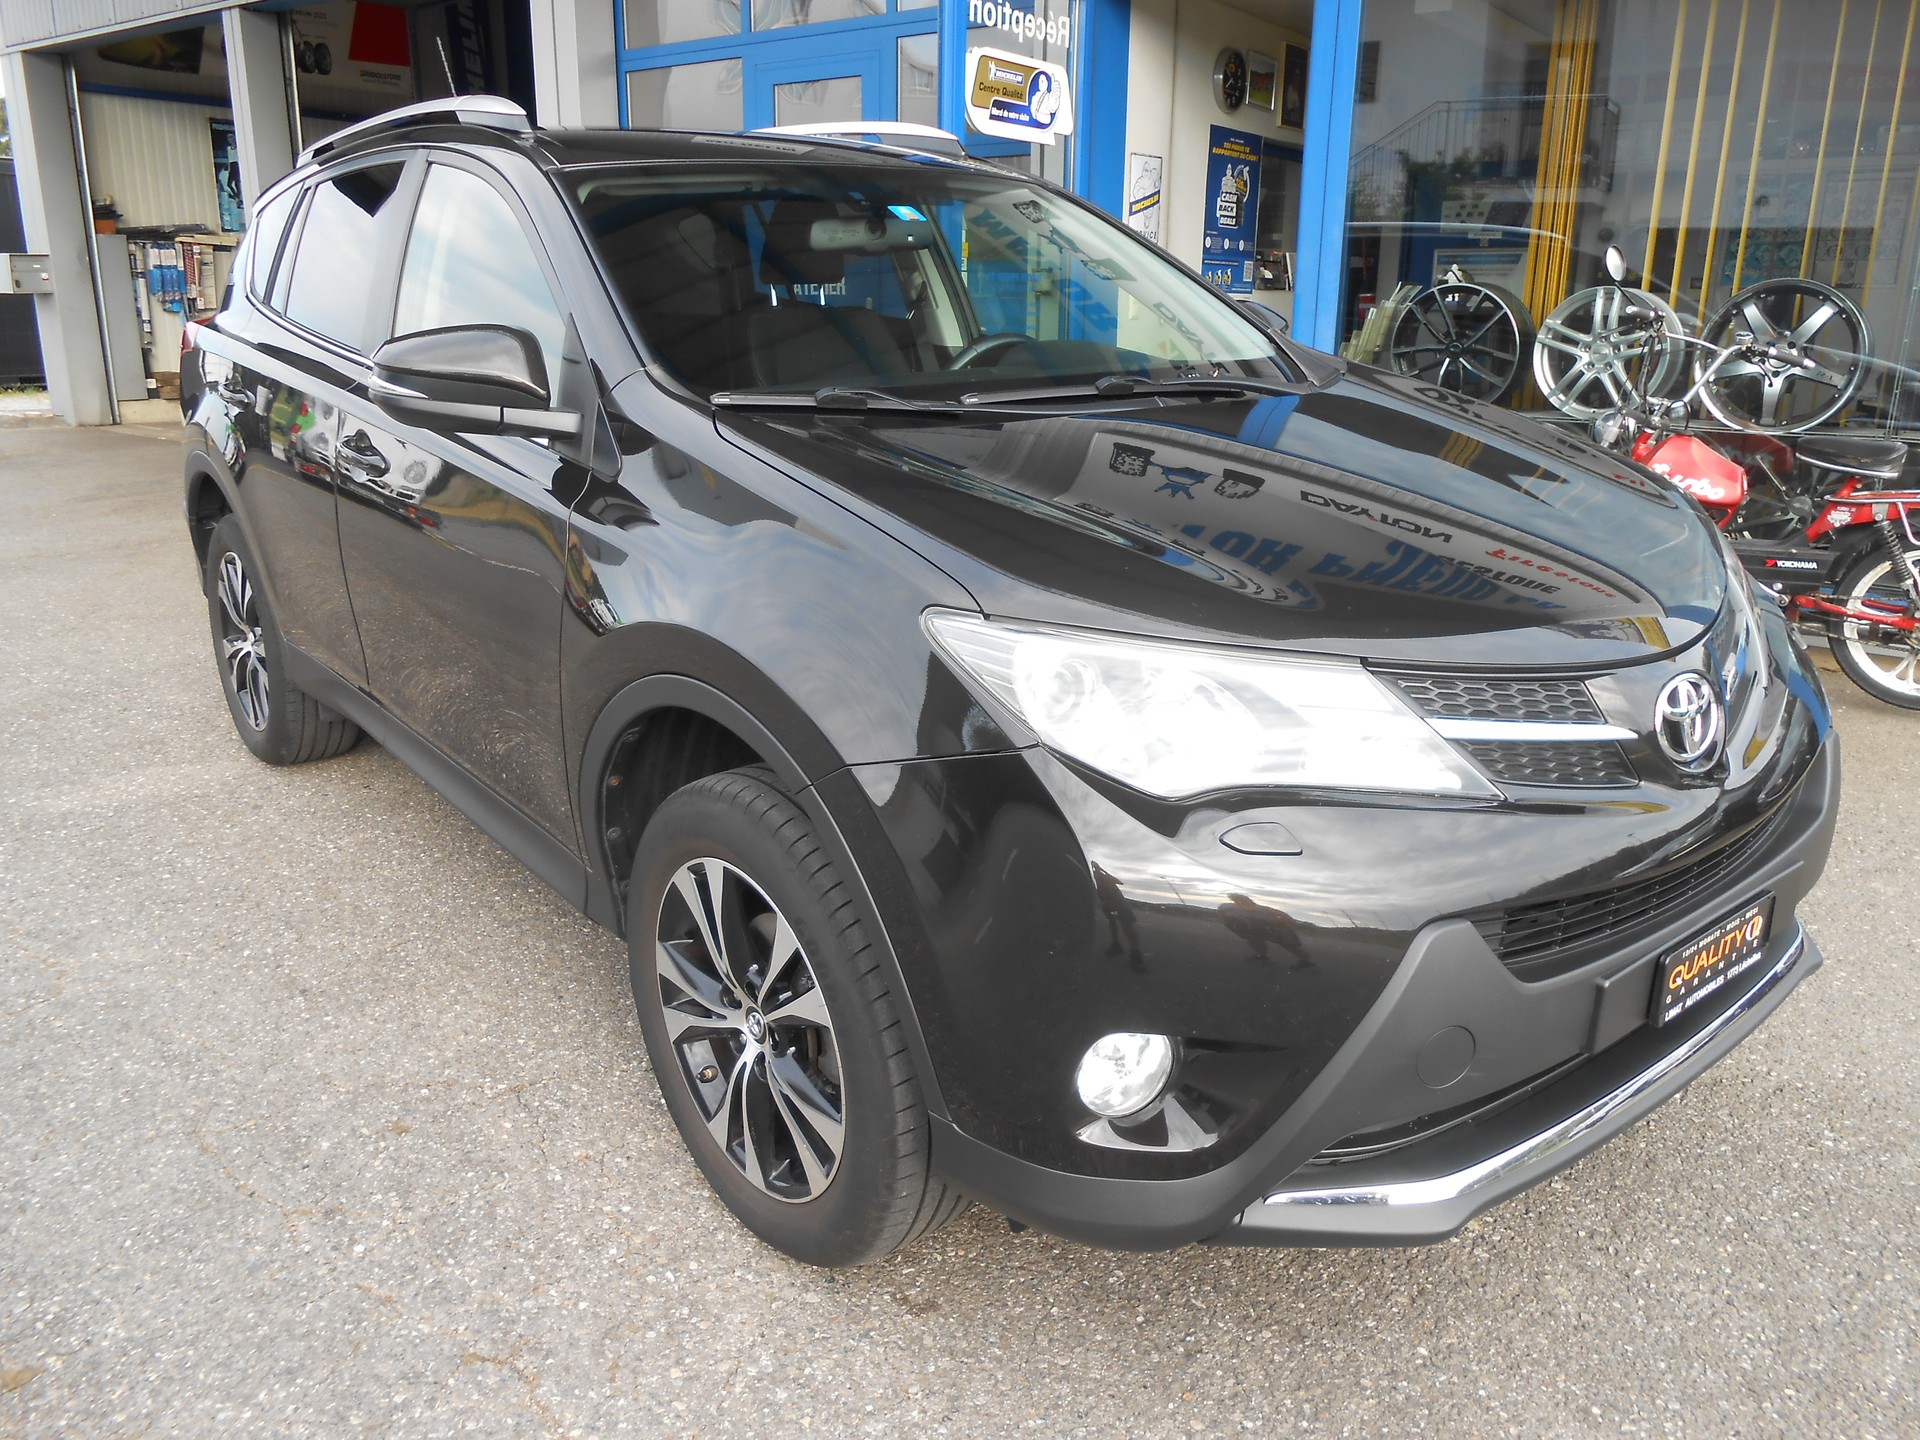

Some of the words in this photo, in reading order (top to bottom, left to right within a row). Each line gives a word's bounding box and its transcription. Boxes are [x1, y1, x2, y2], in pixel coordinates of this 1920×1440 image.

[979, 81, 1001, 95] Centre
[1002, 86, 1024, 100] Qualité
[1132, 193, 1160, 213] MICHELIN
[1221, 193, 1238, 203] CASH
[1218, 204, 1235, 214] BACK
[1219, 216, 1236, 225] DEALS
[1135, 230, 1157, 240] RVICE
[793, 276, 846, 296] ATEIER
[1775, 559, 1818, 570] YOKOHAMA
[1665, 938, 1760, 1004] GARANTIE
[1685, 974, 1725, 1008] AUTOMOBILES
